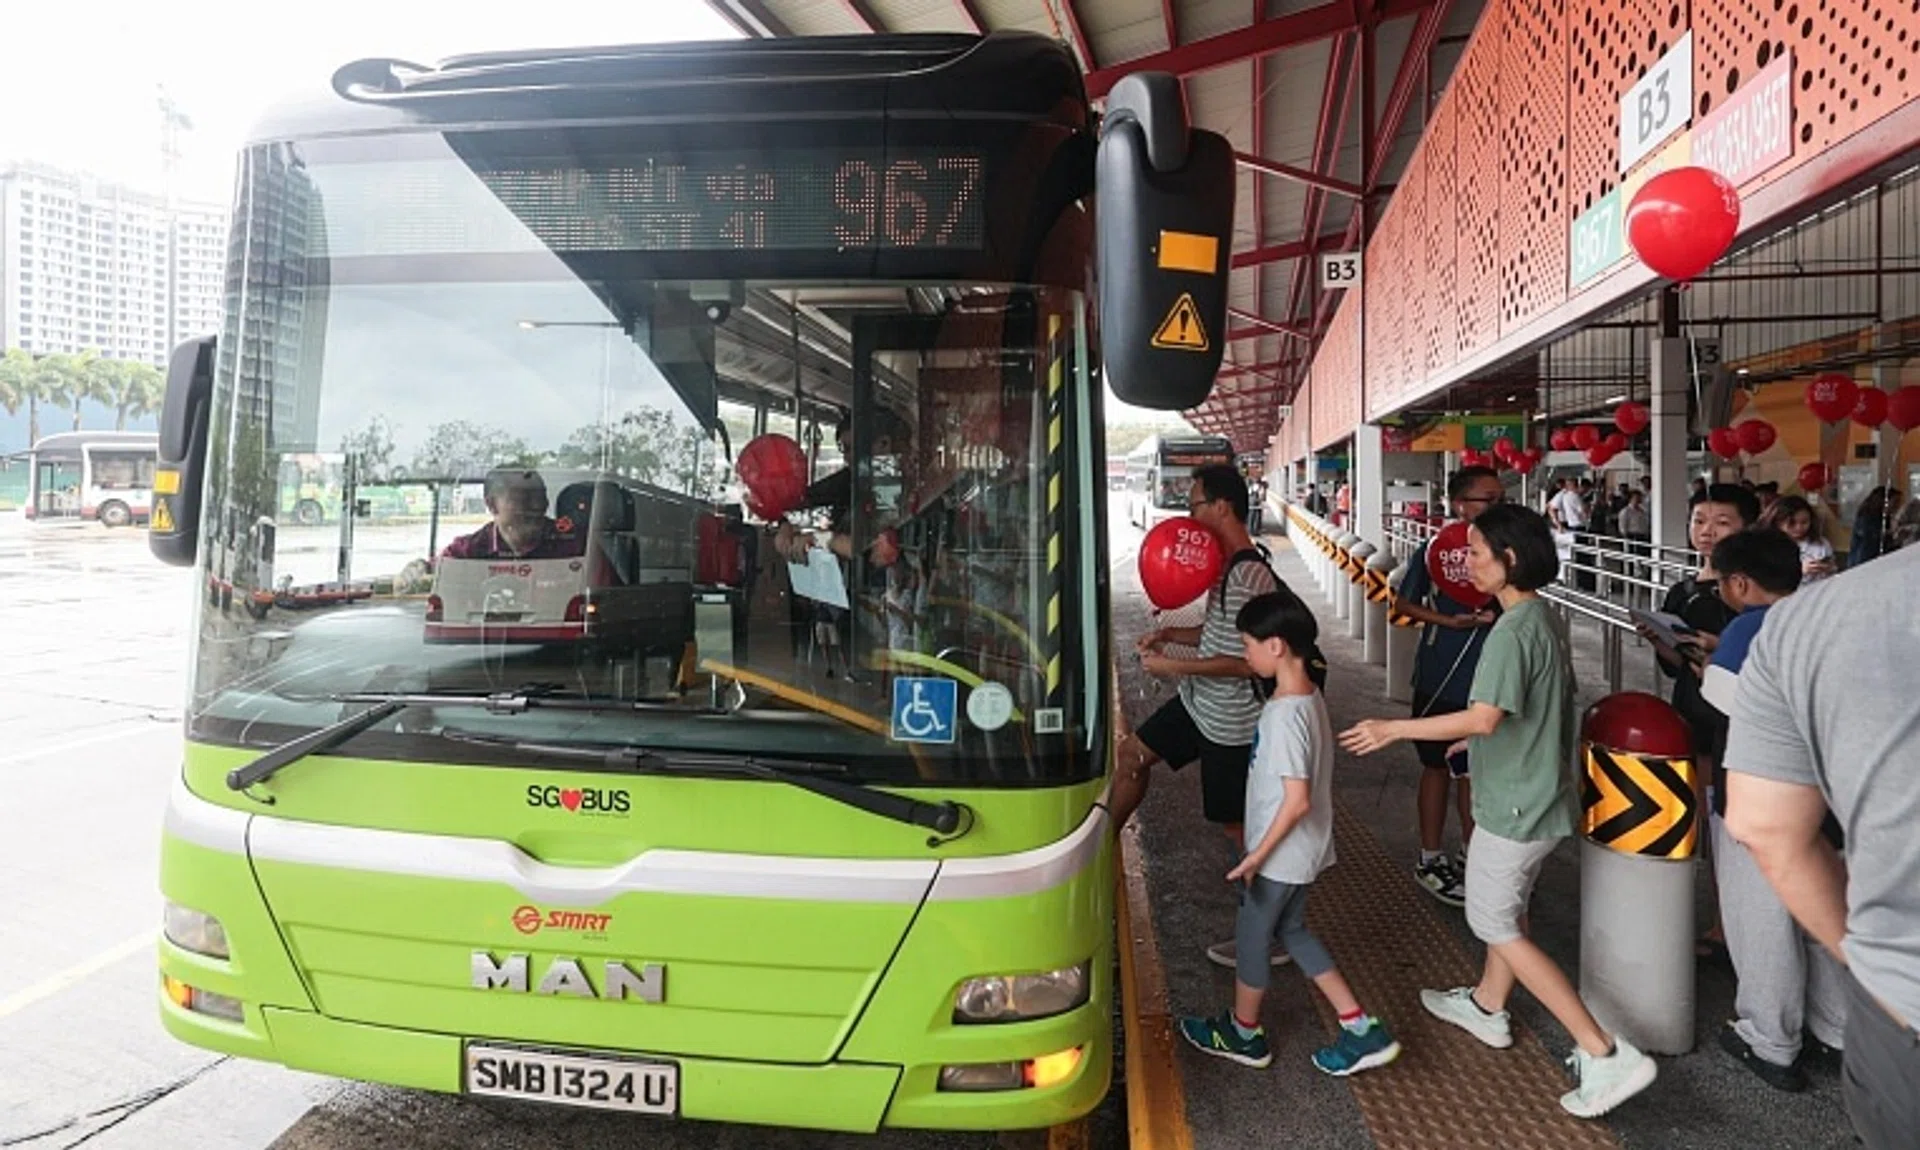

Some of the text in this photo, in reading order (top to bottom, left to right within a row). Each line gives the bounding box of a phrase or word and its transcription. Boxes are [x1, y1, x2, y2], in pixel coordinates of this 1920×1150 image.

[1637, 68, 1671, 145] B3
[834, 157, 980, 246] 967
[719, 211, 765, 249] 41
[1577, 206, 1614, 274] 967
[1327, 259, 1356, 281] B3
[1177, 527, 1212, 548] 967
[544, 910, 613, 932] SMRT
[470, 950, 668, 1004] MAN
